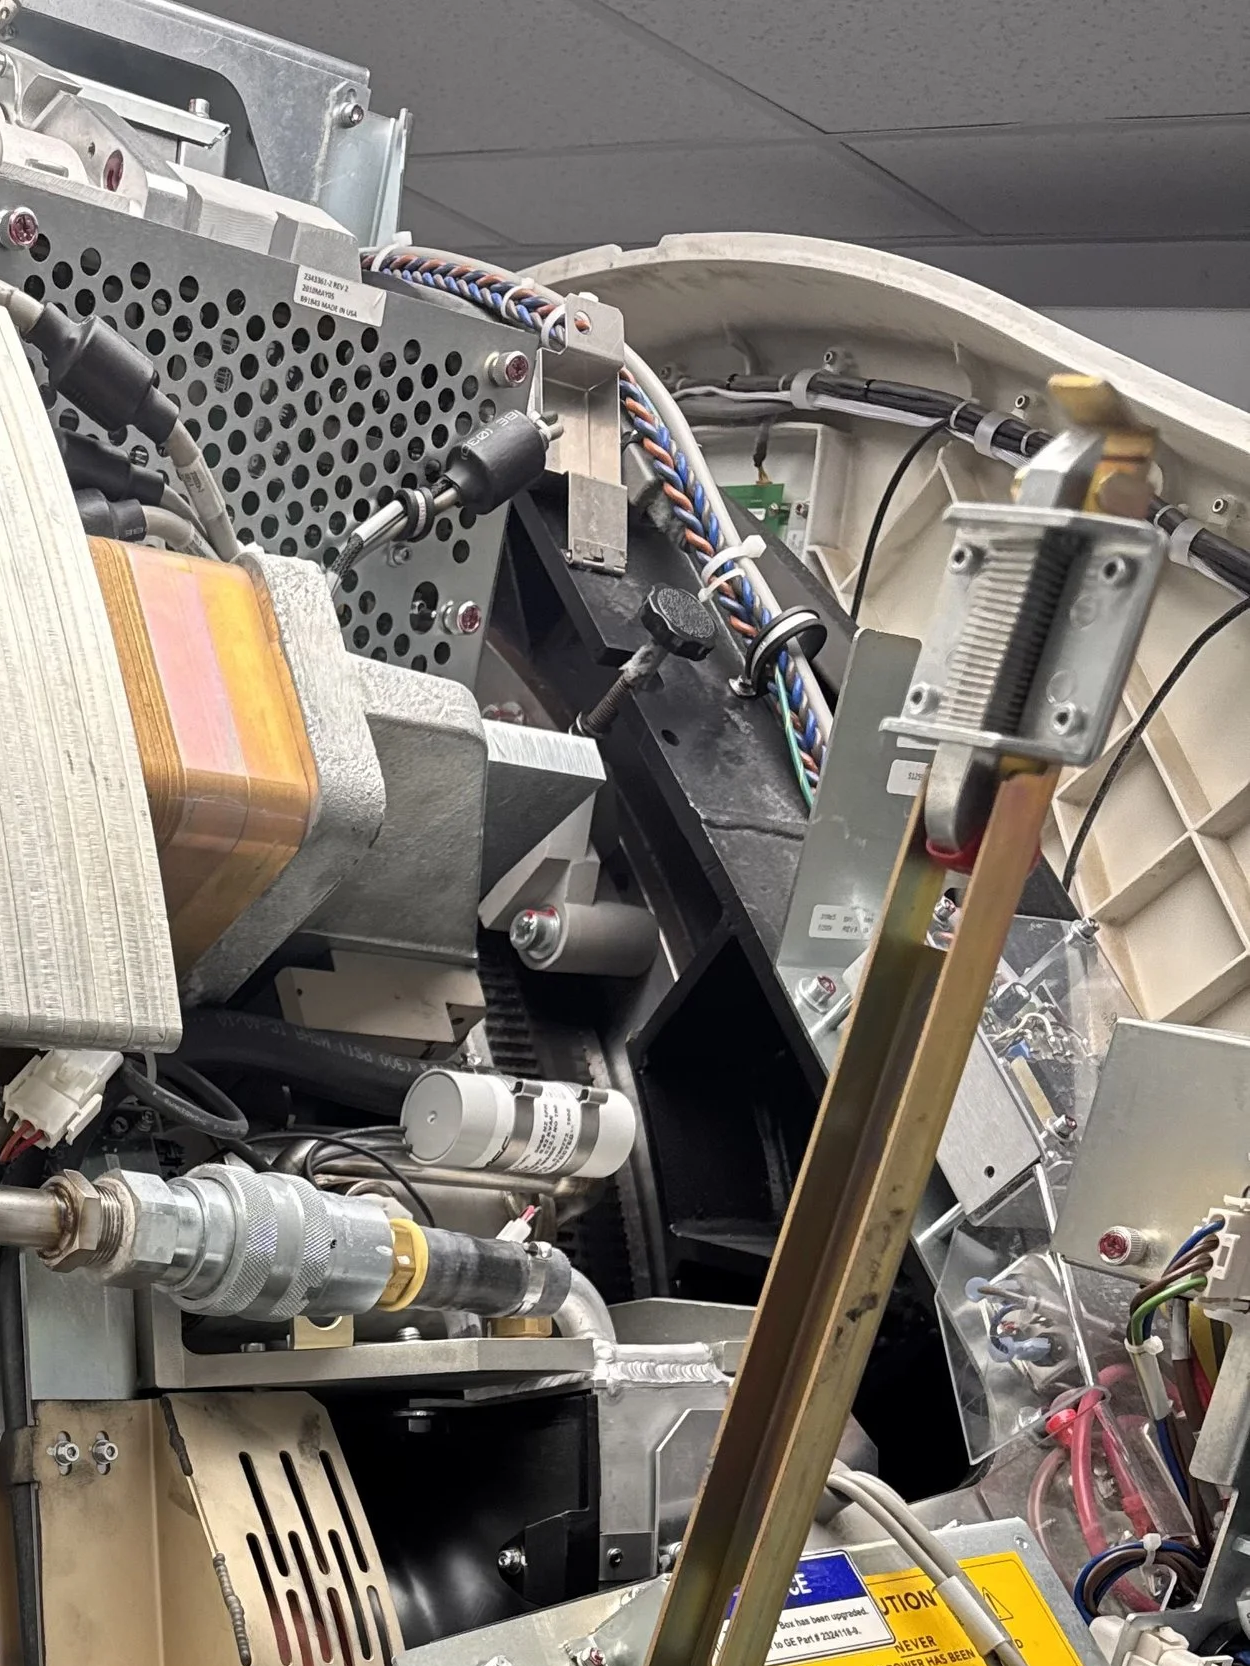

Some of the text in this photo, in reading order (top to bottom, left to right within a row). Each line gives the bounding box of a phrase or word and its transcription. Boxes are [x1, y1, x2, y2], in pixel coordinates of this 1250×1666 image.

[881, 1589, 938, 1617] UTION
[778, 1606, 870, 1630] Box has been upgraded.
[774, 1640, 784, 1650] to
[783, 1637, 798, 1649] GE
[798, 1633, 815, 1645] Part
[895, 1634, 937, 1654] NEVER
[948, 1648, 976, 1664] BEEN
